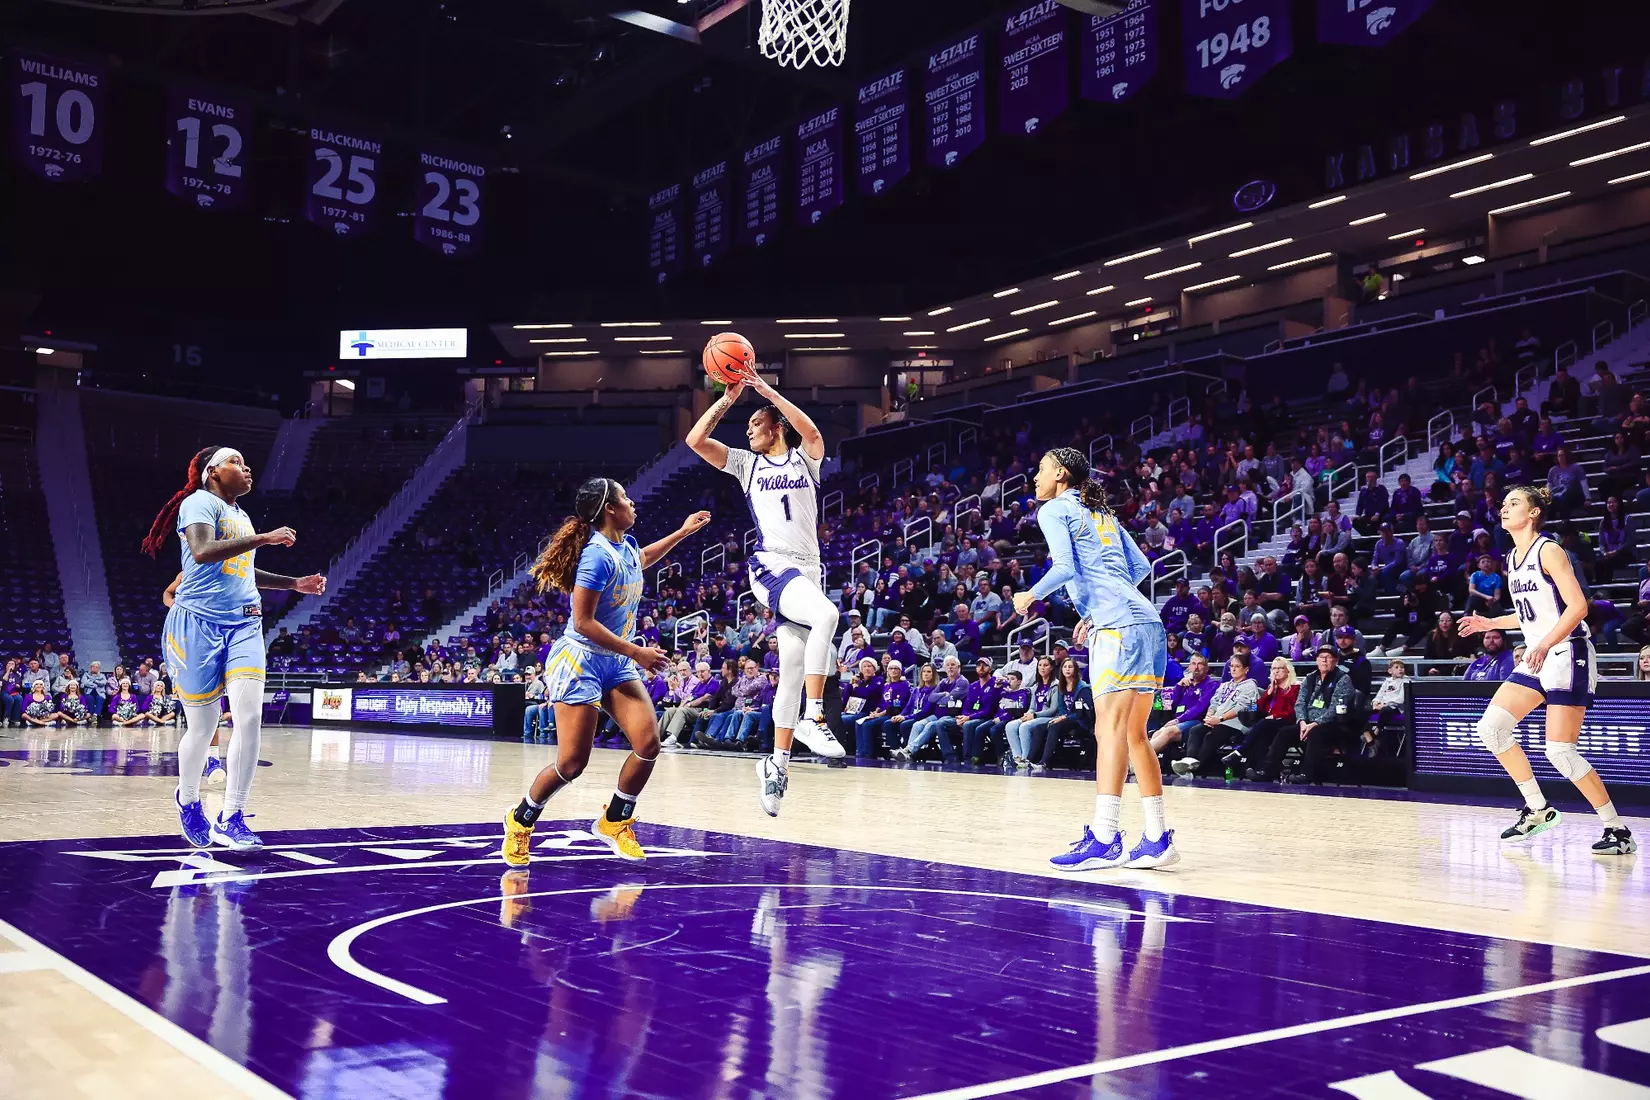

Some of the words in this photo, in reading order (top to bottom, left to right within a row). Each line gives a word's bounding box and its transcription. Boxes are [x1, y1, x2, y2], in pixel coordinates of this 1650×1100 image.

[1124, 13, 1145, 29] 1964
[1095, 26, 1115, 41] 1951
[1124, 26, 1145, 41] 1972
[1196, 16, 1271, 68] 1948
[928, 35, 978, 69] K-STATE
[1004, 47, 1030, 67] SWEET
[1030, 31, 1063, 55] SIXTEEN
[1095, 38, 1115, 54] 1958
[1124, 39, 1146, 54] 1973
[1095, 51, 1115, 66] 1959
[1124, 51, 1146, 67] 1975
[20, 58, 99, 87] WILLIAMS
[1010, 65, 1028, 79] 2018
[1096, 64, 1115, 78] 1961
[858, 70, 904, 100] K-STATE
[925, 84, 950, 102] SWEET
[950, 70, 980, 91] SIXTEEN
[1010, 76, 1028, 91] 2023
[21, 81, 95, 144] 10
[188, 98, 235, 119] EVANS
[933, 101, 948, 113] 1972
[798, 107, 839, 136] K-STATE
[855, 114, 878, 132] SWEET
[878, 103, 905, 122] SIXTEEN
[933, 112, 948, 124] 1973
[932, 123, 948, 136] 1975
[955, 124, 972, 138] 2010
[177, 116, 243, 178] 12
[311, 128, 381, 154] BLACKMAN
[932, 134, 948, 147] 1977
[29, 144, 82, 164] 1972-76
[420, 152, 485, 177] RICHMOND
[182, 176, 232, 194] 197-78
[313, 148, 376, 205] 25
[423, 172, 480, 227] 23
[322, 205, 365, 222] 1977-81
[431, 226, 471, 243] 1986-88
[377, 340, 415, 348] MEDICAL
[418, 340, 456, 348] CENTER
[172, 343, 202, 366] 15
[757, 474, 809, 492] Wildcats
[781, 494, 792, 522] 1
[1515, 597, 1537, 624] 30
[396, 696, 418, 716] Enjoy
[420, 696, 473, 718] Responsibly
[475, 697, 492, 715] 21+
